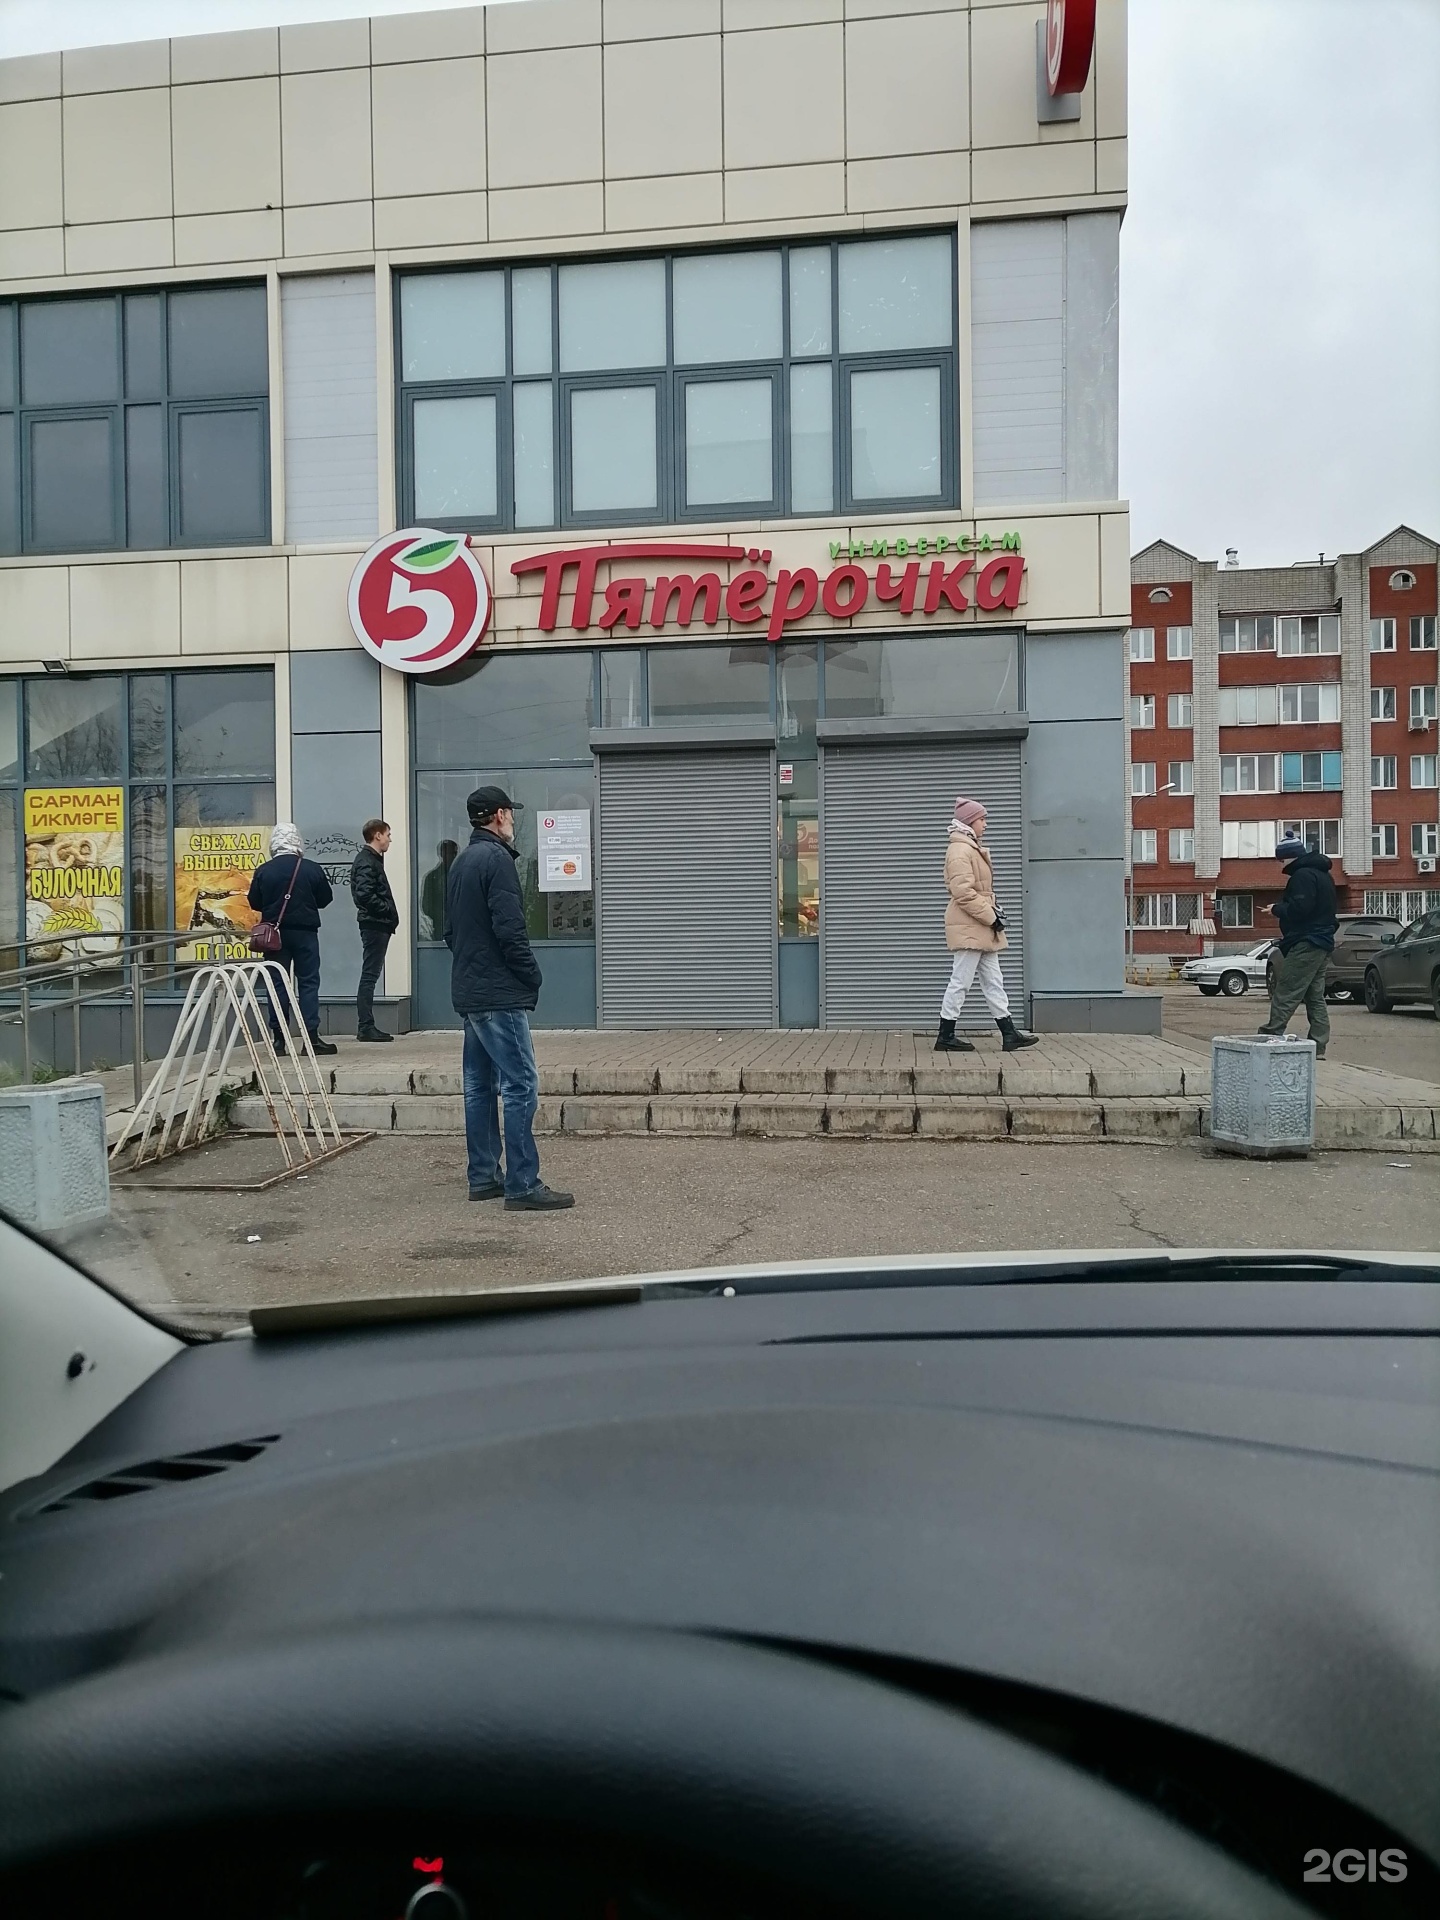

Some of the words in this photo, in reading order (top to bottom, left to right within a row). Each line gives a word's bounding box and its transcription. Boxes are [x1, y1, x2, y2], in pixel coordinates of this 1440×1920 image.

[829, 531, 1022, 559] УНИВЕРСАМ
[511, 543, 1026, 641] Пятёрочка
[378, 570, 455, 662] 5
[29, 793, 120, 809] САРМАН
[190, 833, 261, 851] СВЕЖАЯ
[183, 853, 266, 871] ВЫПЕЧКА
[31, 866, 122, 899] БУЛОЧНАЯ
